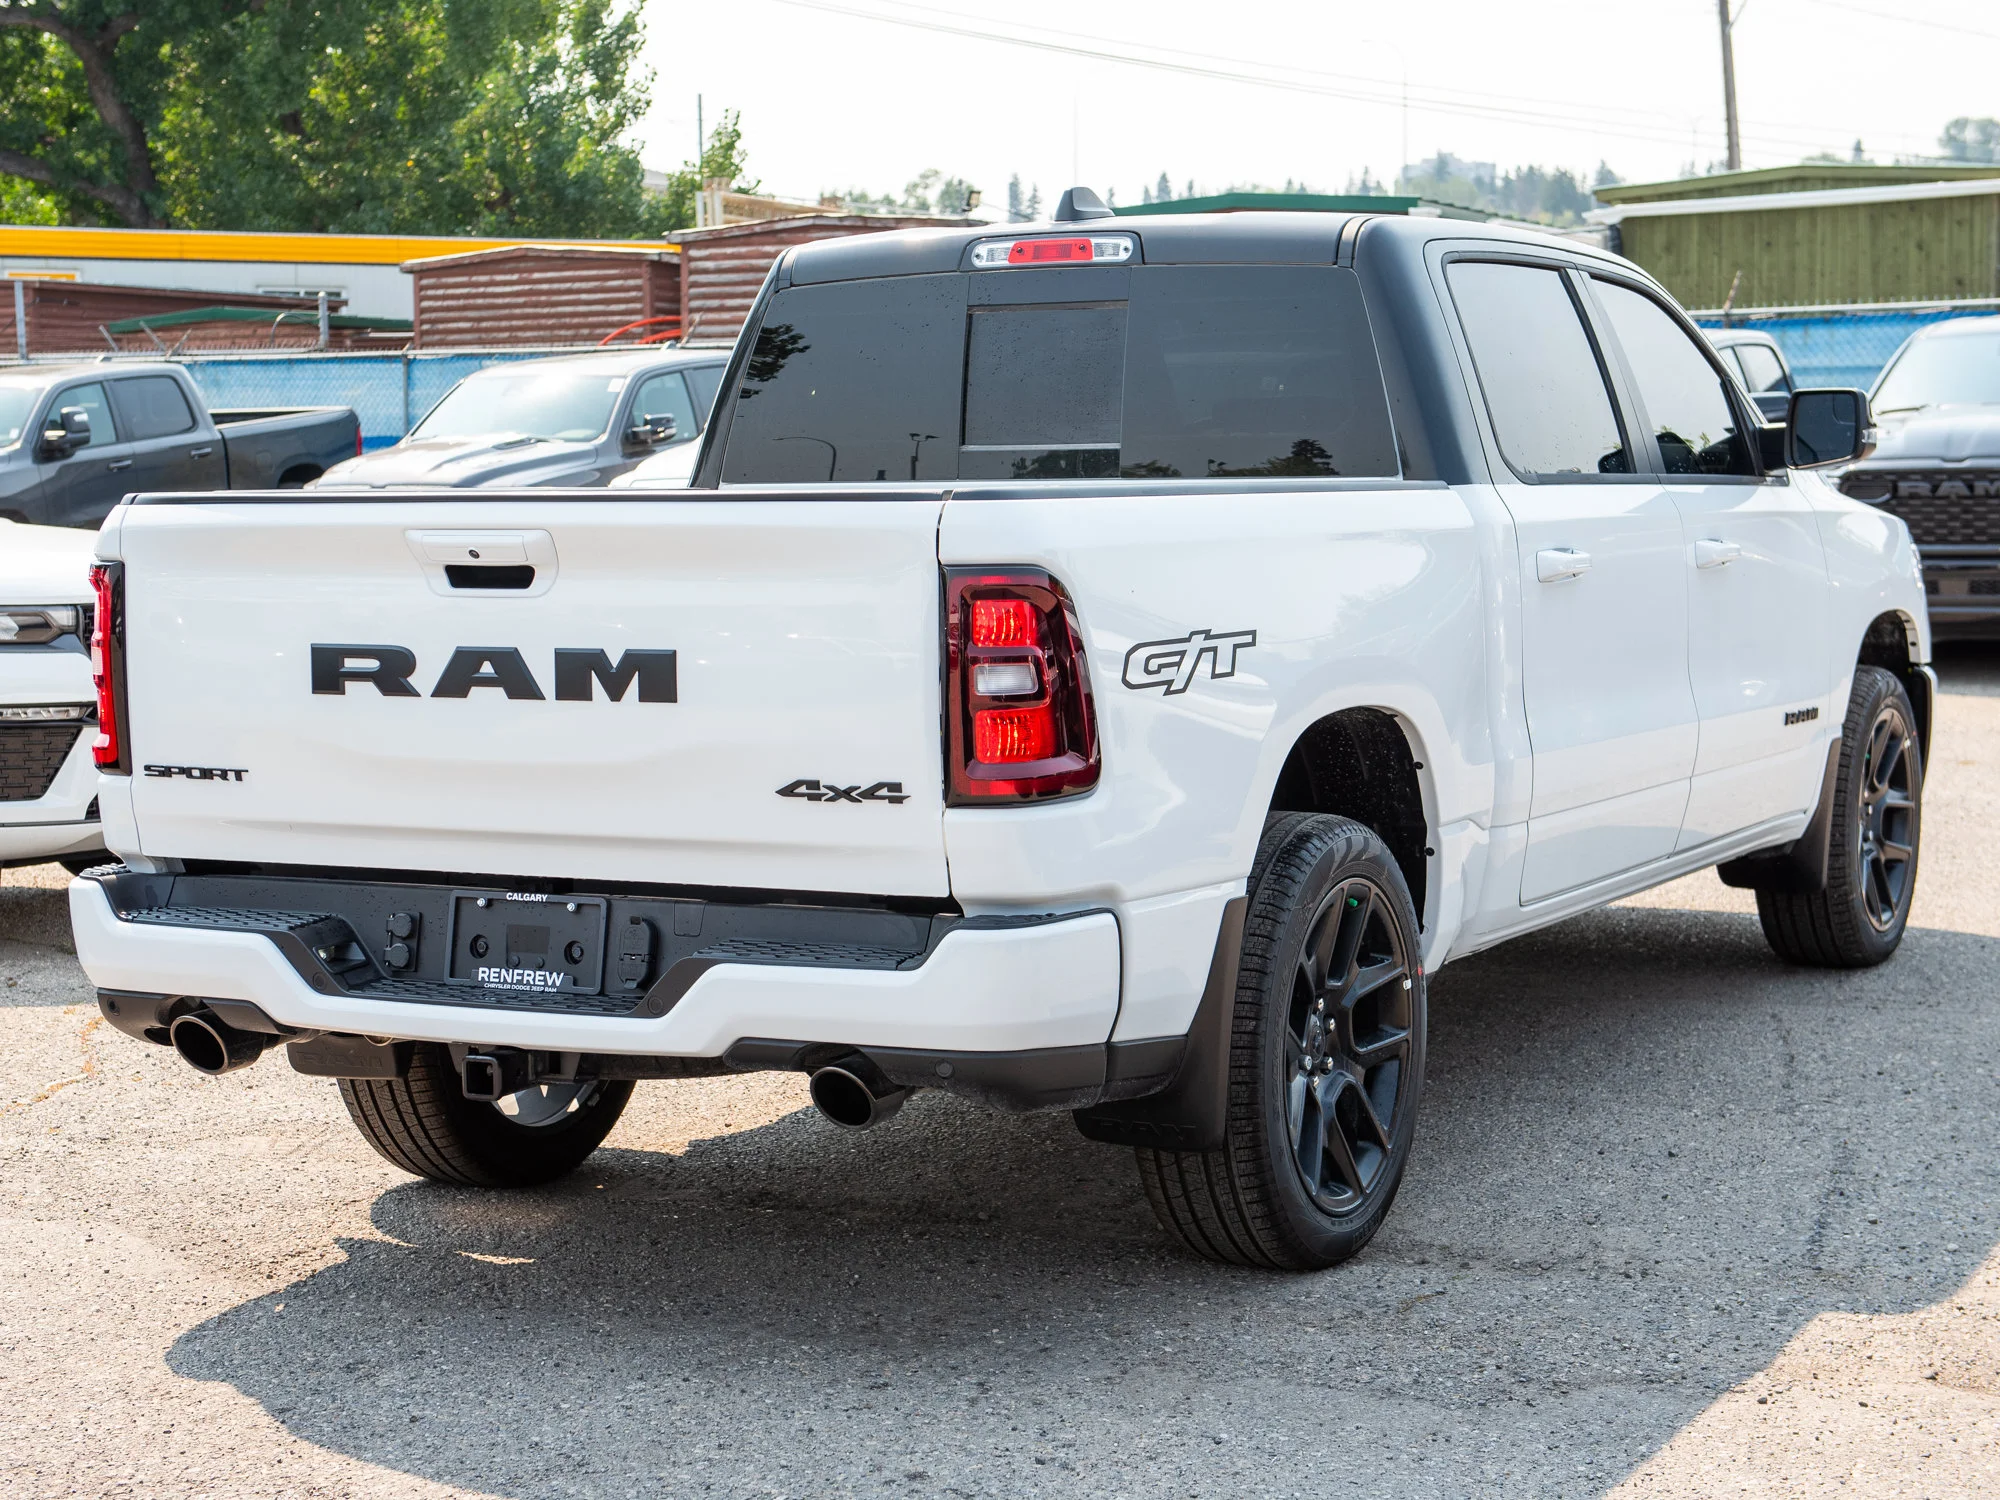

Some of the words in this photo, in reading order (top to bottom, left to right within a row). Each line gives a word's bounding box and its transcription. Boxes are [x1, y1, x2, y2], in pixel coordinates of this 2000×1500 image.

[1897, 480, 2000, 498] RAM
[310, 643, 678, 704] RAM
[1784, 706, 1819, 727] RAM
[143, 764, 249, 782] SPORT
[506, 892, 548, 902] CALGARY
[478, 967, 565, 987] RENFREW
[484, 982, 511, 990] CHRYSLER
[511, 984, 531, 992] DODGE
